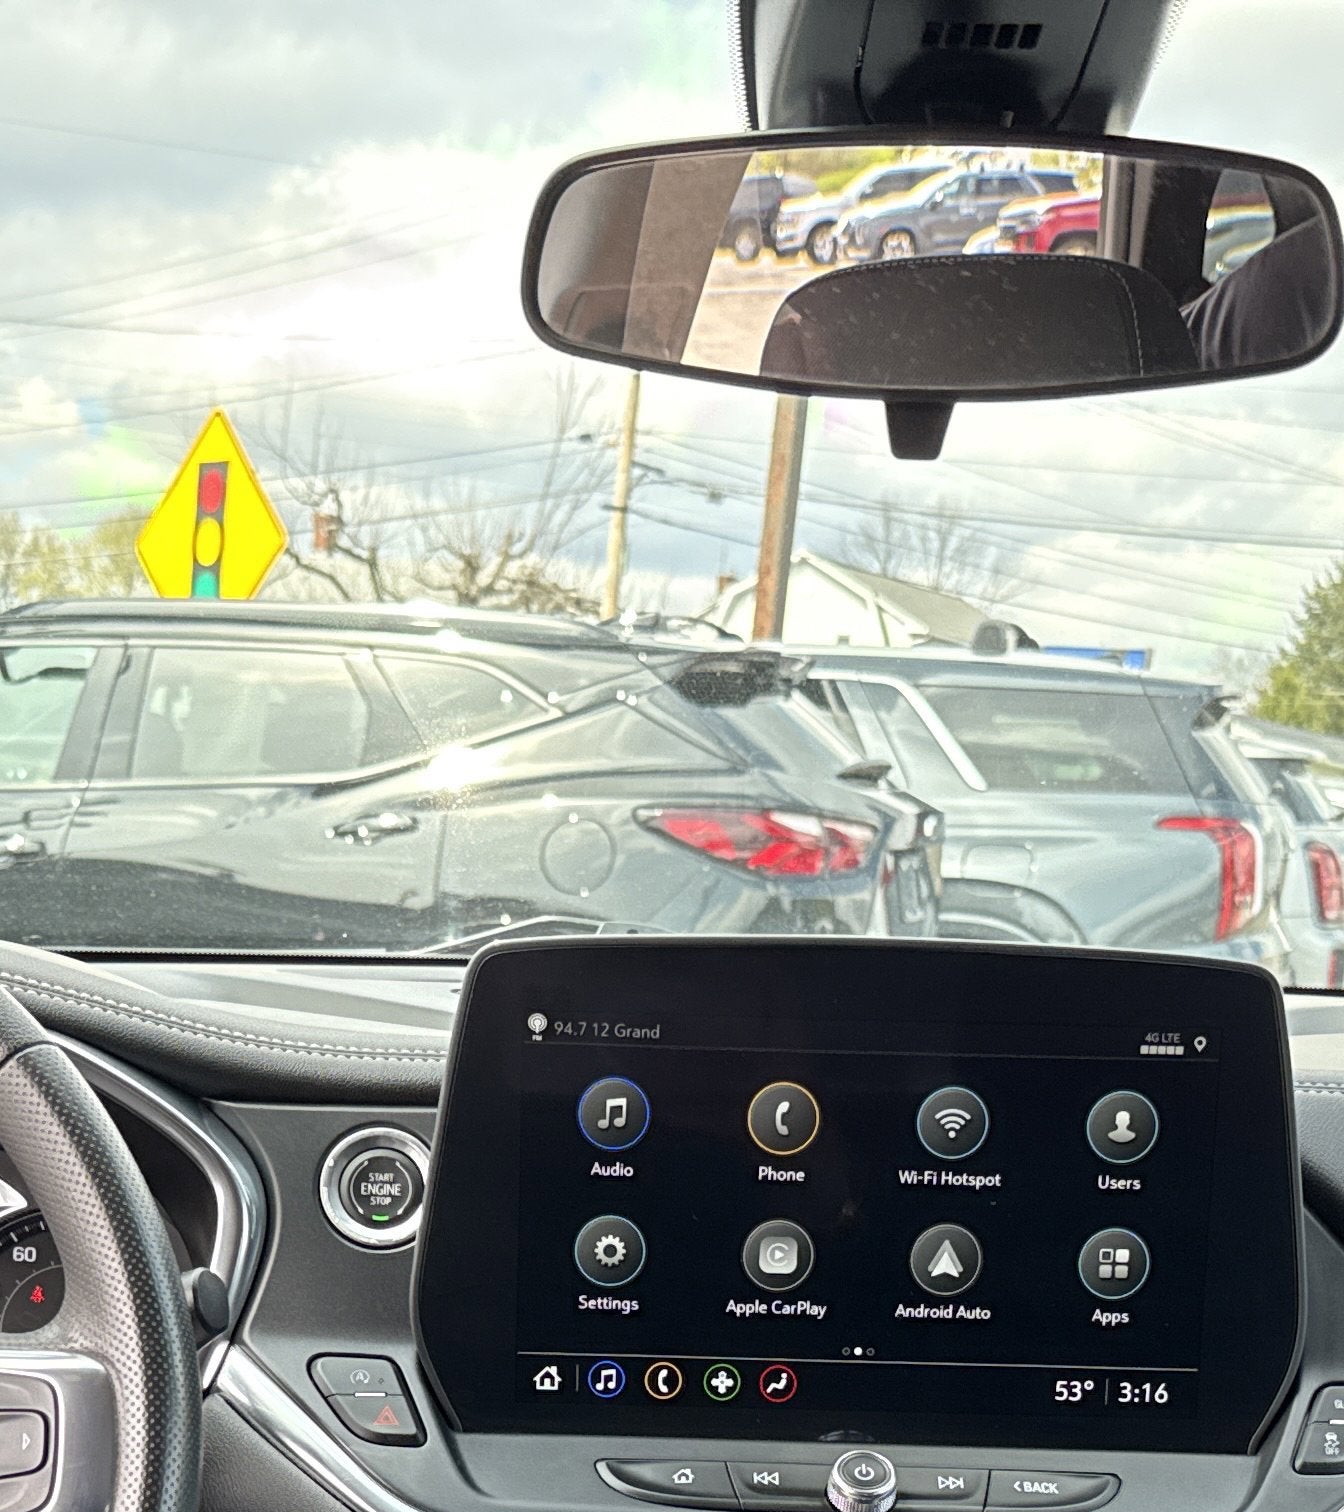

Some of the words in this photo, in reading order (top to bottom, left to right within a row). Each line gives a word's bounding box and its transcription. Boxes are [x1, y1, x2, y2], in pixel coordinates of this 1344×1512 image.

[554, 1021, 587, 1037] 94.7
[592, 1023, 610, 1038] 12
[614, 1023, 661, 1040] Grand
[1144, 1032, 1160, 1044] 4G
[1162, 1032, 1182, 1044] LTE
[368, 1172, 394, 1183] START
[590, 1161, 634, 1178] Audio
[758, 1166, 806, 1182] Phone
[898, 1169, 937, 1186] Wi-Fi
[941, 1171, 1002, 1190] Hotspot
[1098, 1175, 1141, 1190] Users
[360, 1182, 402, 1197] ENGINE
[369, 1196, 393, 1206] STOP
[12, 1246, 37, 1263] 60
[578, 1295, 639, 1314] Settings
[726, 1299, 768, 1318] Apple
[771, 1301, 827, 1319] CarPlay
[895, 1304, 953, 1320] Android
[956, 1305, 991, 1321] Auto
[1091, 1309, 1130, 1327] Apps
[1118, 1382, 1169, 1404] 3:16
[1022, 1481, 1058, 1495] BACK
